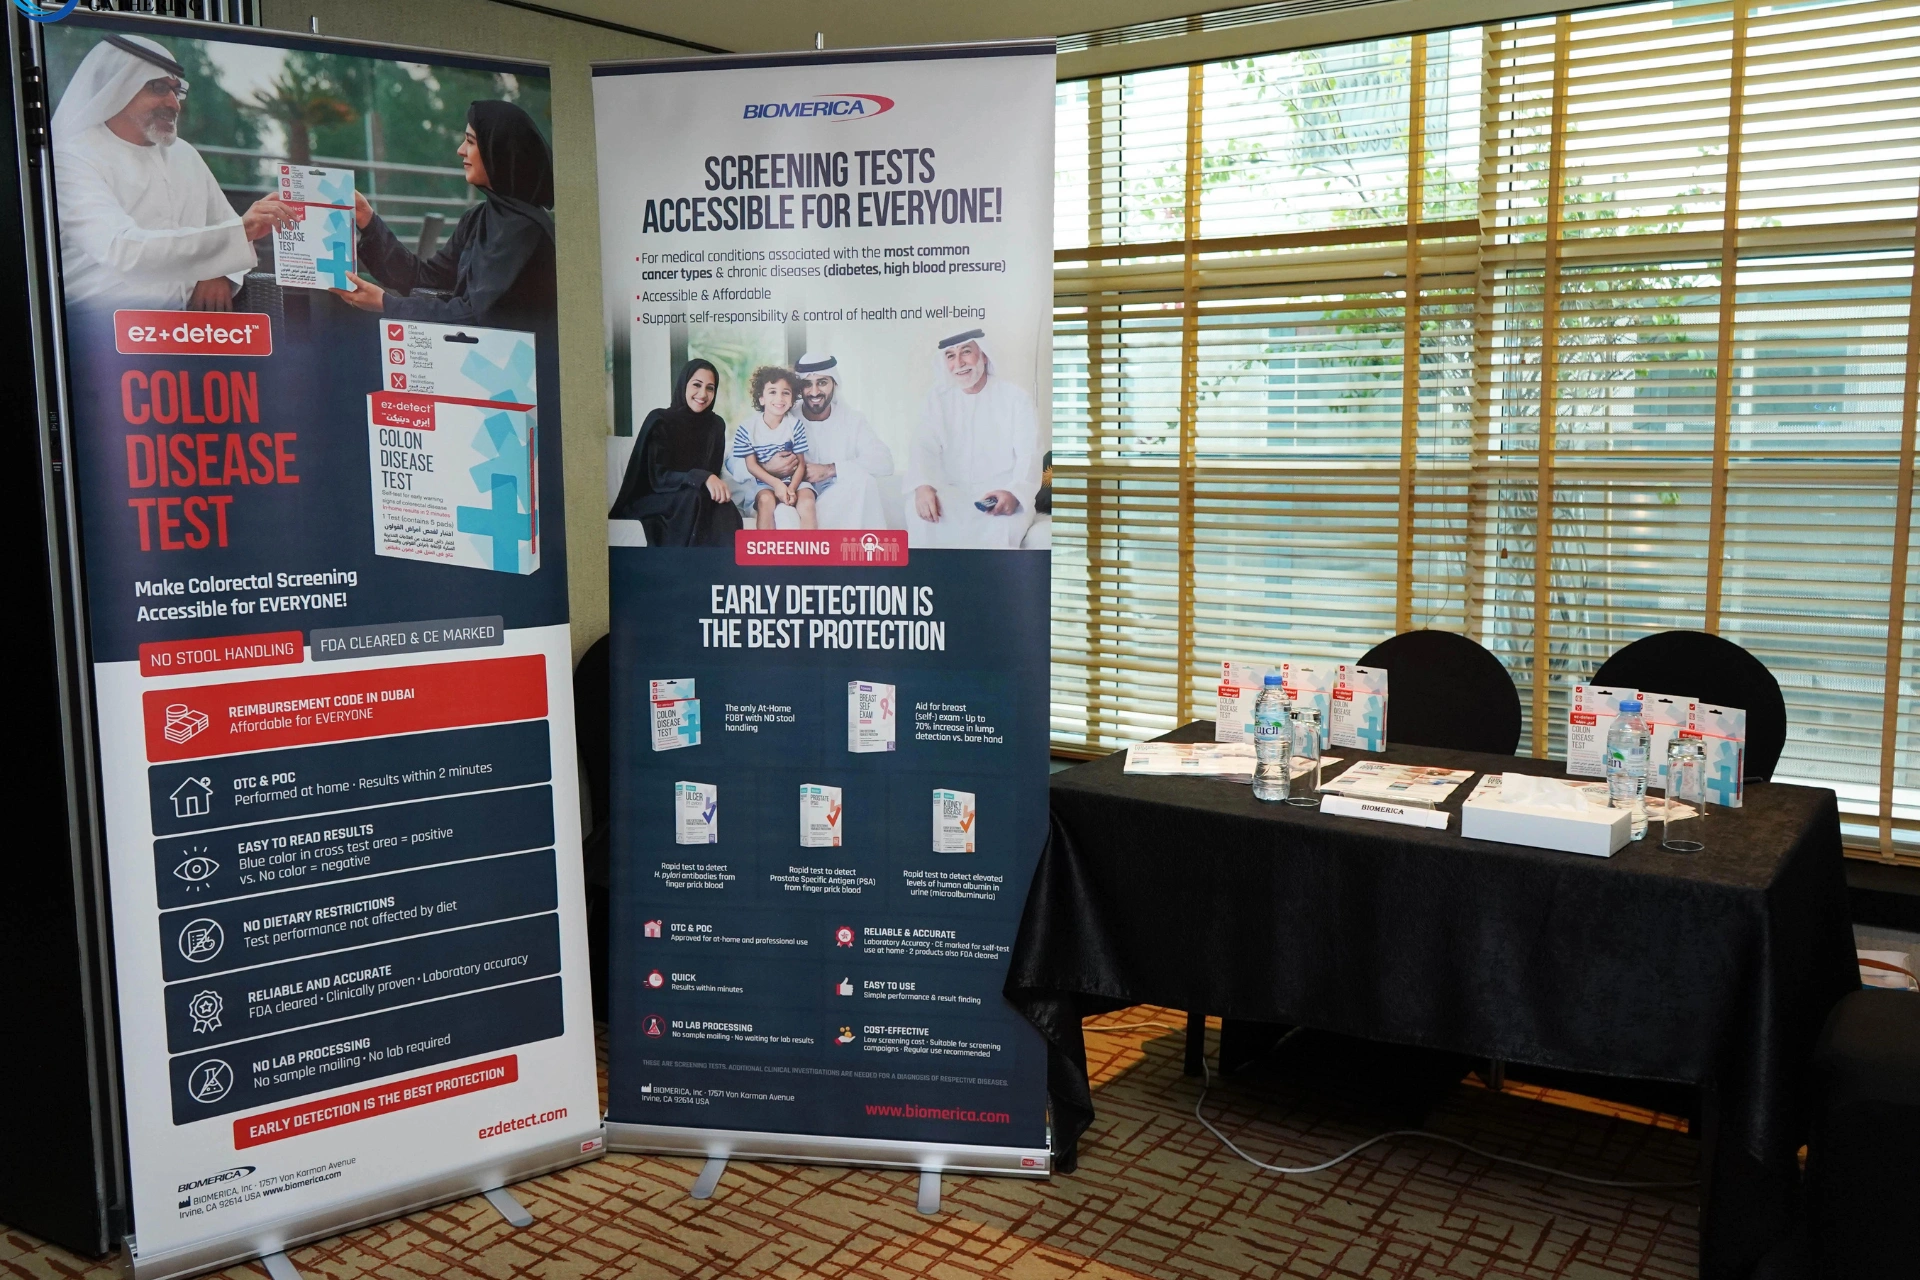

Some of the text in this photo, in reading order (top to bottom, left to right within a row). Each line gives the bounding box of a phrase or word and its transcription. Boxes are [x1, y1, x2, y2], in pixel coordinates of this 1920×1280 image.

[743, 100, 865, 119] BIOMERICA
[704, 147, 934, 190] SCREENING TESTS
[642, 187, 1001, 233] ACCESSIBLE FOR EVERYONE!
[279, 242, 295, 252] TEST
[641, 245, 969, 264] For medical conditions associated with the most common
[641, 287, 771, 302] Accessible & Affordable
[120, 370, 260, 425] COLON
[380, 428, 422, 450] COLON
[125, 432, 298, 488] DISEASE
[380, 450, 434, 472] DISEASE
[382, 470, 413, 490] TEST
[127, 495, 232, 551] TEST
[436, 520, 454, 528] pads)
[746, 541, 829, 554] SCREENING
[135, 571, 357, 597] Make Colorectal Screening
[711, 584, 933, 616] EARLY DETECTION IS
[137, 592, 346, 621] Accessible for EVERYONE!
[320, 626, 494, 651] FDA CLEARED & CE MARKED
[698, 618, 944, 650] THE BEST PROTECTION
[151, 642, 293, 666] NO STOOL HANDLING
[228, 688, 414, 717] REIMBURSEMENT CODE IN DUBAI
[860, 694, 877, 702] BREAST
[725, 703, 791, 713] The only At-Home
[860, 702, 870, 710] SELF
[1334, 700, 1348, 708] COLON
[656, 709, 676, 720] COLON
[725, 713, 743, 721] FOBT
[776, 714, 794, 722] stool
[860, 710, 873, 719] EXAM
[1334, 708, 1351, 716] DISEASE
[229, 707, 373, 733] Affordable for EVERYONE
[657, 718, 681, 728] DISEASE
[658, 728, 672, 738] TEST
[725, 723, 758, 733] handling
[1572, 725, 1590, 733] COLON
[1572, 734, 1594, 742] DISEASE
[1572, 741, 1585, 749] TEST
[233, 771, 295, 790] OTC & POC
[686, 792, 703, 801] ULCER
[810, 794, 829, 802] PROSTATE
[943, 800, 962, 808] KIDNEY
[1361, 804, 1404, 815] BIOMERICA
[943, 807, 962, 816] DISEASE
[237, 823, 373, 854] EASY TO READ RESULTS
[661, 862, 680, 870] Rapid
[705, 863, 727, 871] detect
[661, 871, 680, 879] pylori
[718, 872, 735, 880] from
[665, 879, 685, 888] finger
[686, 880, 703, 888] prick
[243, 896, 394, 932] NO DIETARY RESTRICTIONS
[670, 923, 686, 931] OTC
[696, 924, 712, 932] POC
[864, 927, 955, 938] RELIABLE & ACCURATE
[671, 973, 696, 982] QUICK
[248, 964, 391, 1003] RELIABLE AND ACCURATE
[717, 985, 743, 993] minutes
[864, 980, 915, 990] EASY TO USE
[672, 1020, 752, 1031] NO LAB PROCESSING
[863, 1025, 928, 1035] COST-EFFECTIVE
[252, 1037, 370, 1073] NO LAB PROCESSING
[653, 1086, 691, 1095] BIOMERICA,
[740, 1091, 767, 1099] Karman
[768, 1093, 794, 1101] Avenue
[249, 1066, 504, 1138] EARLY DETECTION IS THE BEST PROTECTION
[864, 1103, 1011, 1125] www.biomerica.com
[478, 1107, 567, 1139] ezdetect.com
[178, 1170, 242, 1193] BIOMERICA
